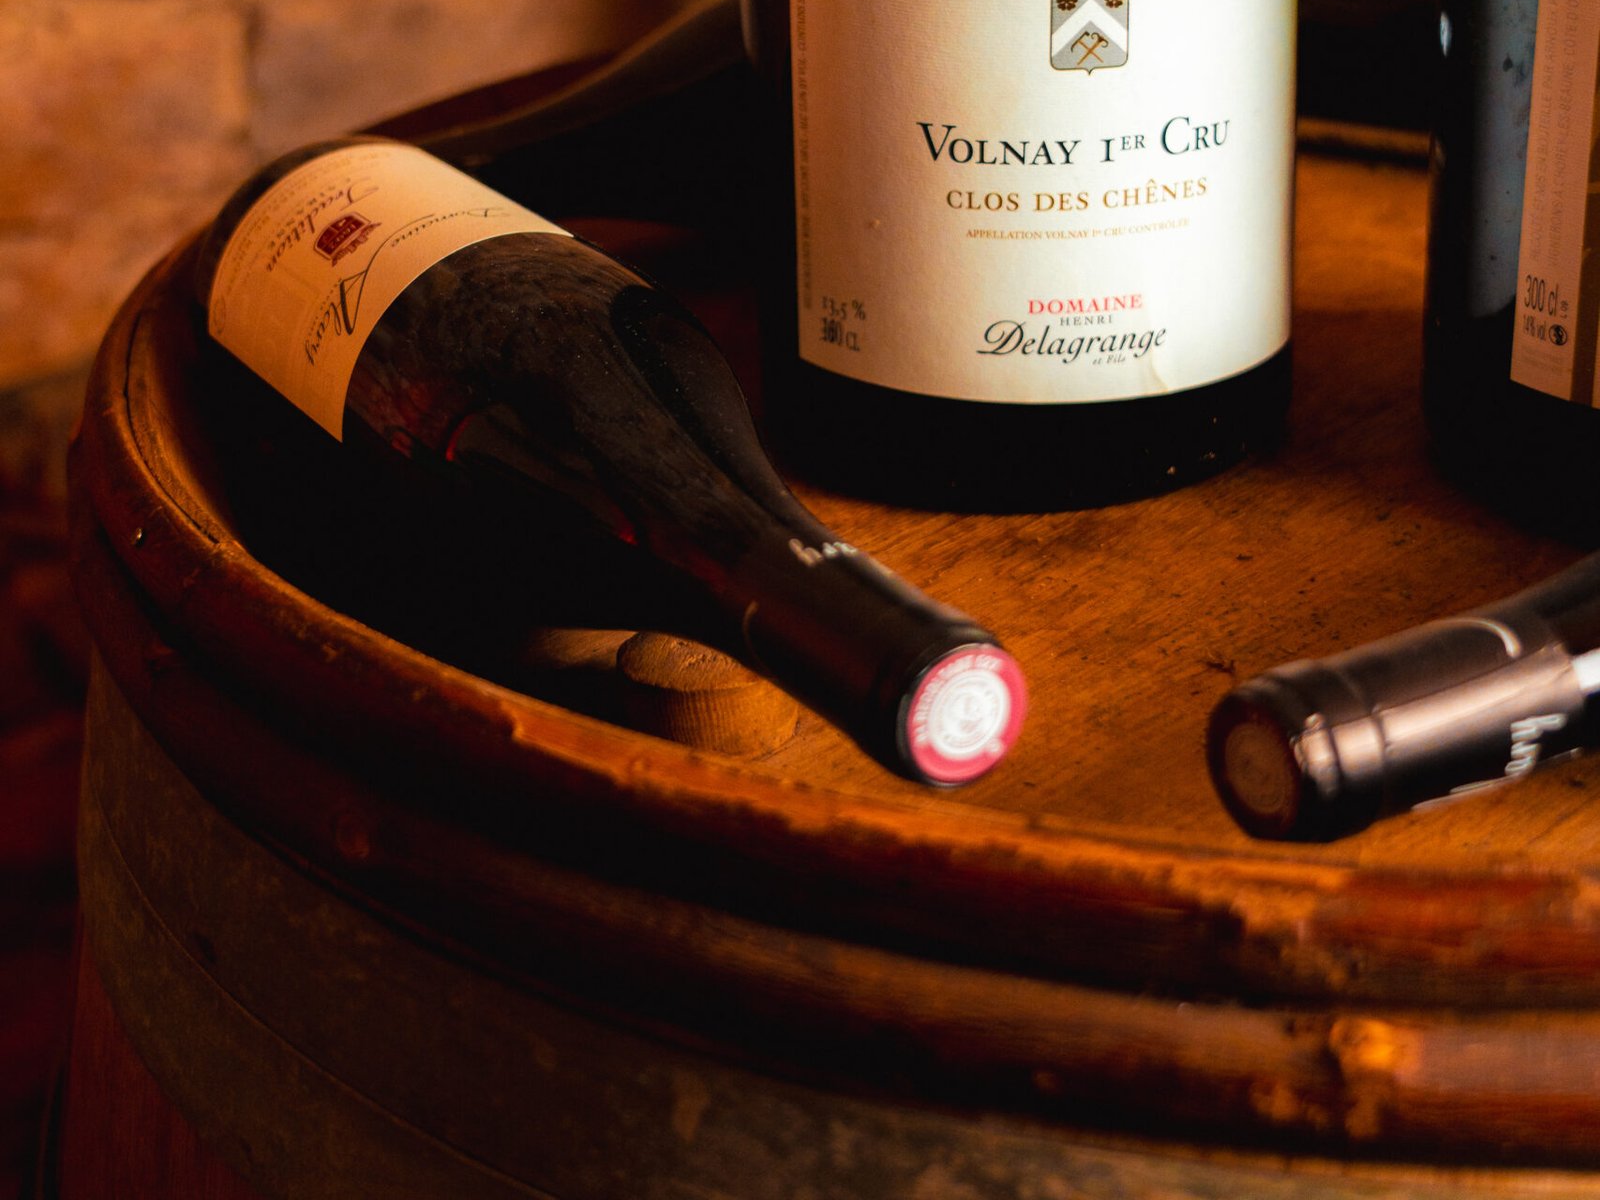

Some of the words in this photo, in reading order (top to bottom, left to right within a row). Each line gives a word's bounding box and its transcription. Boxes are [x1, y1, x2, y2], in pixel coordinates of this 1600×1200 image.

[916, 122, 1081, 166] VOLNAY
[1160, 117, 1231, 156] CRU
[946, 189, 1020, 212] CLOS
[1034, 191, 1090, 212] DES
[1103, 177, 1209, 210] CHÊNES
[264, 177, 380, 273] Tradition
[966, 228, 1042, 240] APPELLATION
[1045, 229, 1089, 240] VOLNAY
[1028, 293, 1144, 315] DOMAINE
[1524, 274, 1546, 312] 300
[1548, 283, 1559, 317] cl
[1059, 314, 1114, 327] HENRI
[976, 319, 1167, 364] Delagrange
